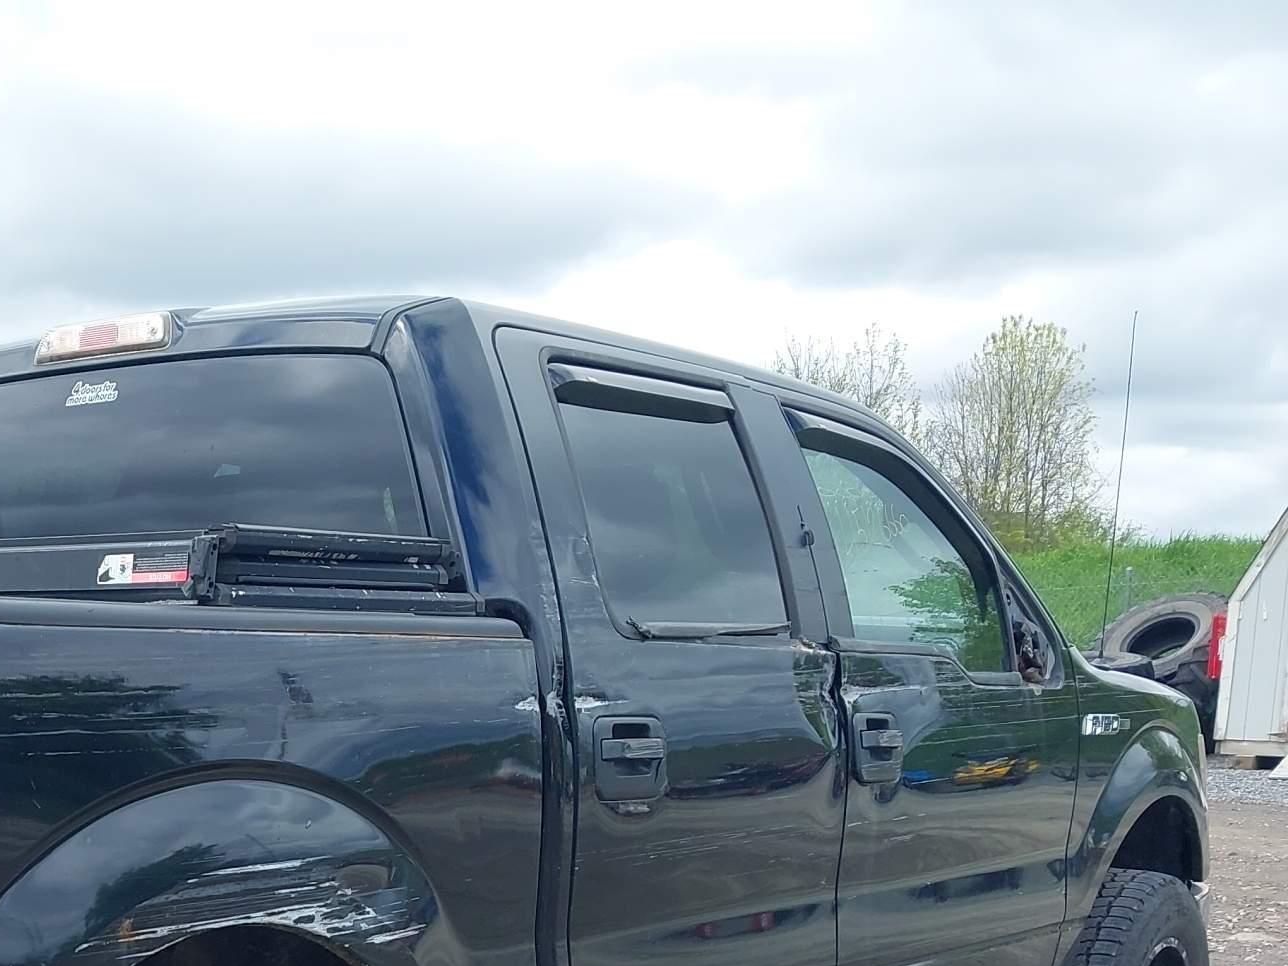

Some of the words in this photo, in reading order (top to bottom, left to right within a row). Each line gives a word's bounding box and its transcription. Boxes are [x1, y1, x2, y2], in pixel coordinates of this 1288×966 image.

[81, 384, 102, 395] doors
[103, 382, 115, 393] for
[66, 395, 87, 406] more
[88, 391, 117, 403] whores
